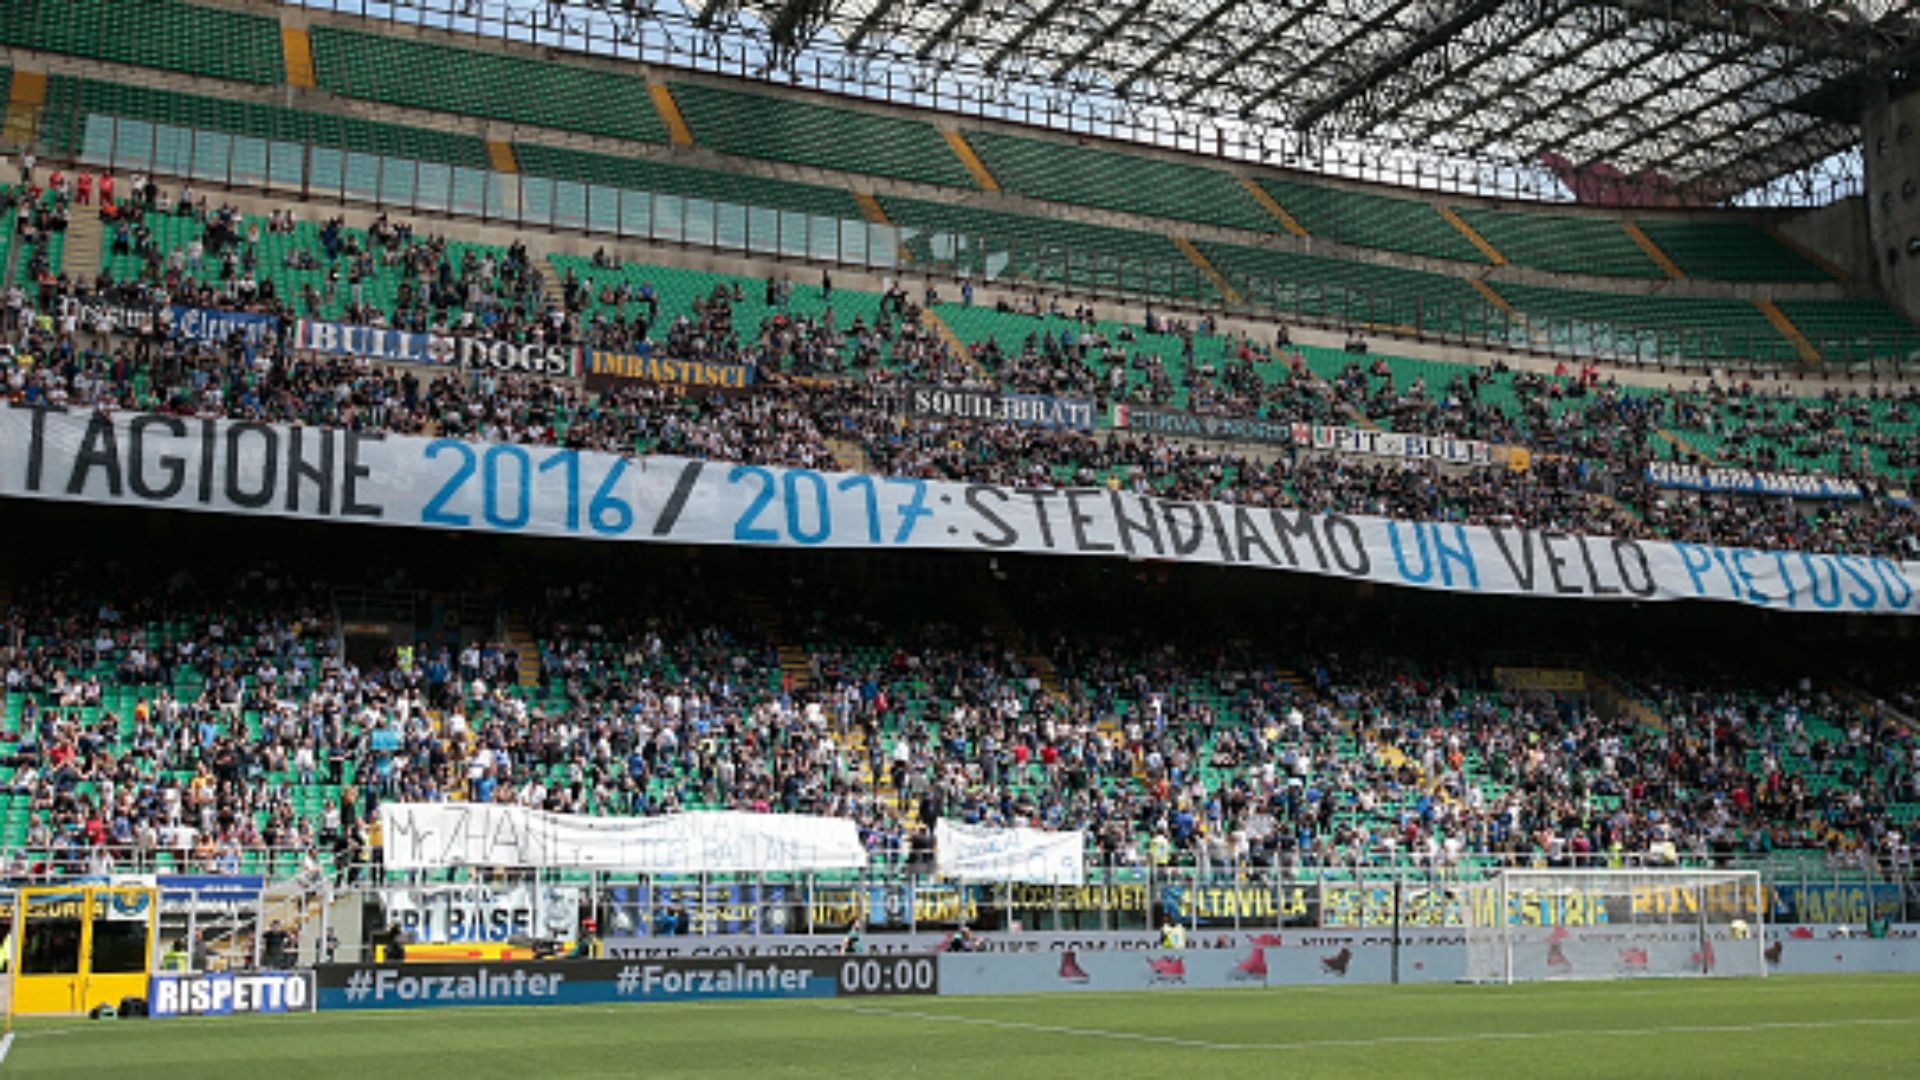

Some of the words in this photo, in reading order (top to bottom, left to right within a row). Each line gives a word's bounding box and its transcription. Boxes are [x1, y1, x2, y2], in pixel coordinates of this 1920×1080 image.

[309, 321, 420, 360] BULL
[461, 337, 567, 374] DOGS
[591, 351, 747, 388] IMBASTISCI
[8, 401, 385, 516] TAGIONE
[421, 437, 634, 535] 2016
[965, 484, 1370, 576] STENDIAMO
[1387, 520, 1480, 589] UN
[1492, 524, 1658, 598] VELO
[1180, 886, 1308, 917] ALTAVILLA
[449, 908, 530, 942] BASE
[345, 967, 565, 1001] #ForzaInter
[616, 963, 813, 995] #ForzaInter
[840, 959, 936, 991] 00:00
[155, 975, 308, 1014] RISPETTO
